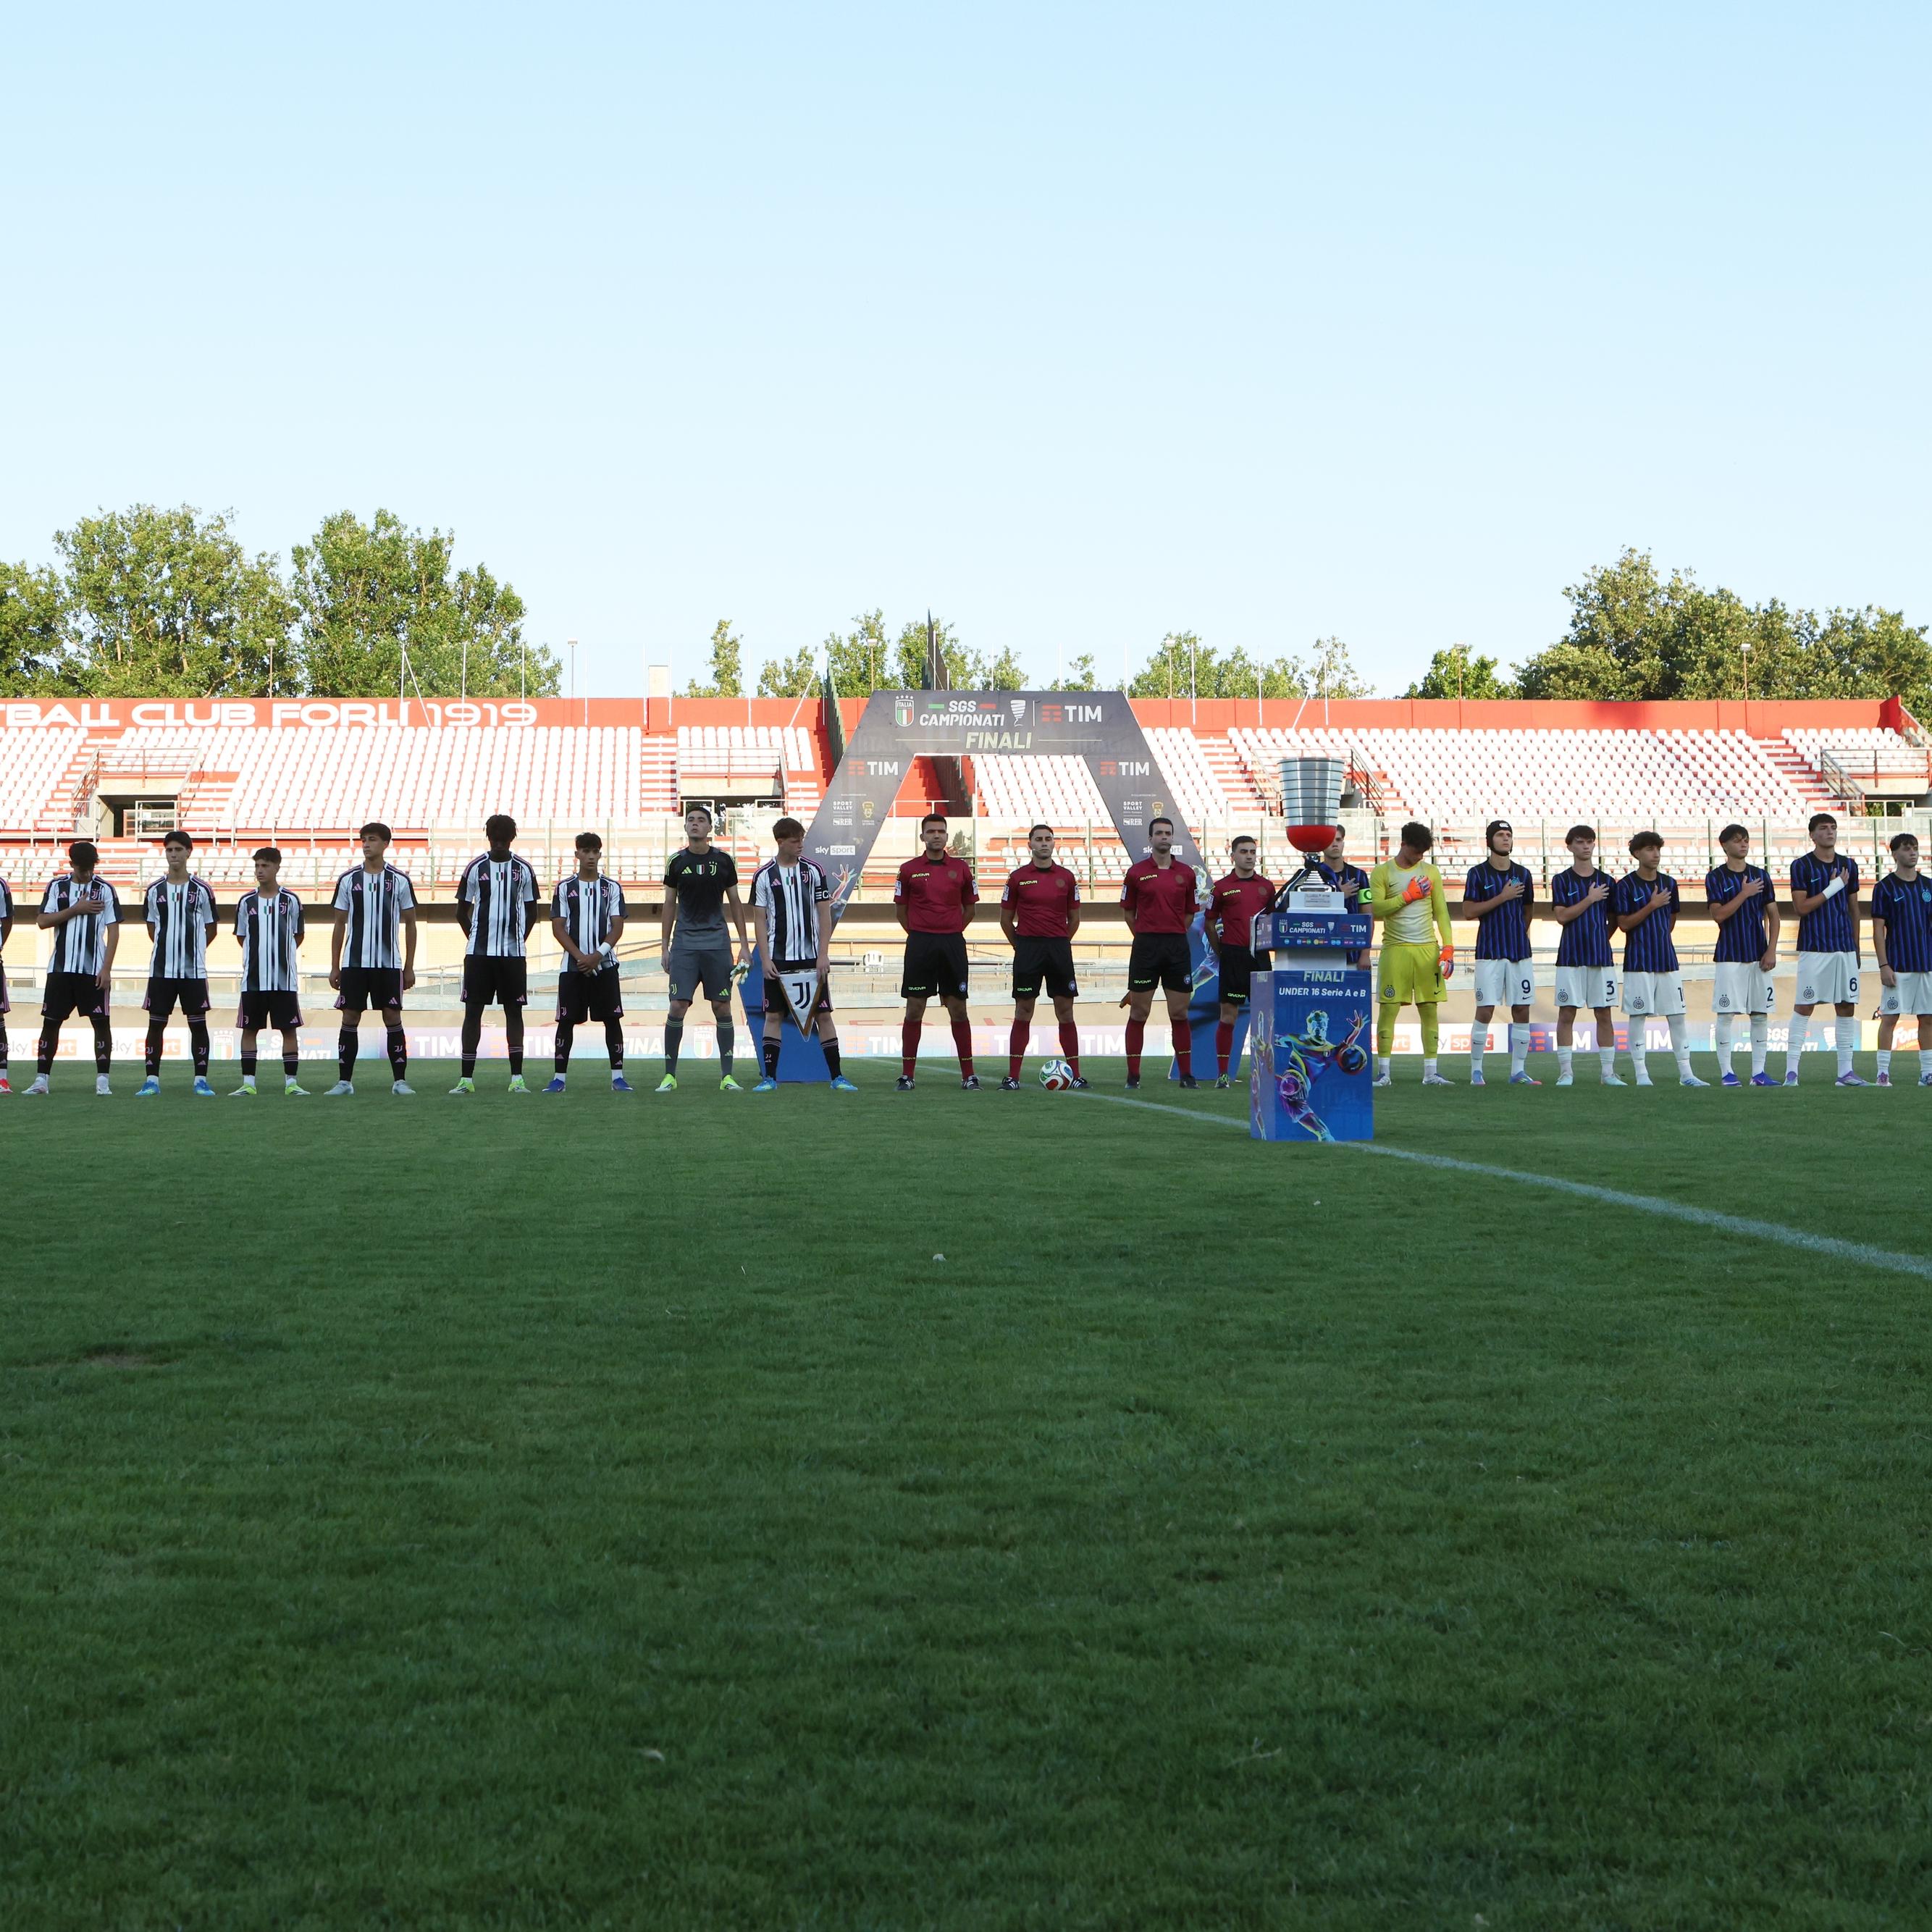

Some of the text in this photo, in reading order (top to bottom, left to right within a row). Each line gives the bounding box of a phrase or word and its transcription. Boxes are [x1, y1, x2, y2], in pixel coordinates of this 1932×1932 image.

[949, 700, 976, 713] SGS
[1065, 705, 1102, 722] TIM
[0, 703, 120, 727] BALL
[131, 703, 256, 727] CLUB
[426, 702, 537, 727] 1919
[919, 713, 1005, 727] CAMPIONATI
[965, 731, 1033, 749] FINALI
[867, 761, 899, 776] TIM
[1119, 761, 1150, 776] TIM
[815, 846, 829, 854] sky
[1303, 970, 1345, 983] FINALI
[1435, 973, 1440, 988] 1
[1279, 987, 1309, 996] UNDER
[1311, 988, 1320, 996] 16
[1322, 988, 1343, 997] Serie
[1360, 989, 1366, 998] B
[1521, 979, 1531, 994] 9
[1606, 980, 1615, 995] 3
[1849, 978, 1857, 992] 6
[1767, 987, 1773, 1001] 2
[414, 1036, 461, 1057] TIM
[1080, 1036, 1126, 1054] TIM
[1548, 1031, 1591, 1051] TM
[1645, 1030, 1673, 1050] IM
